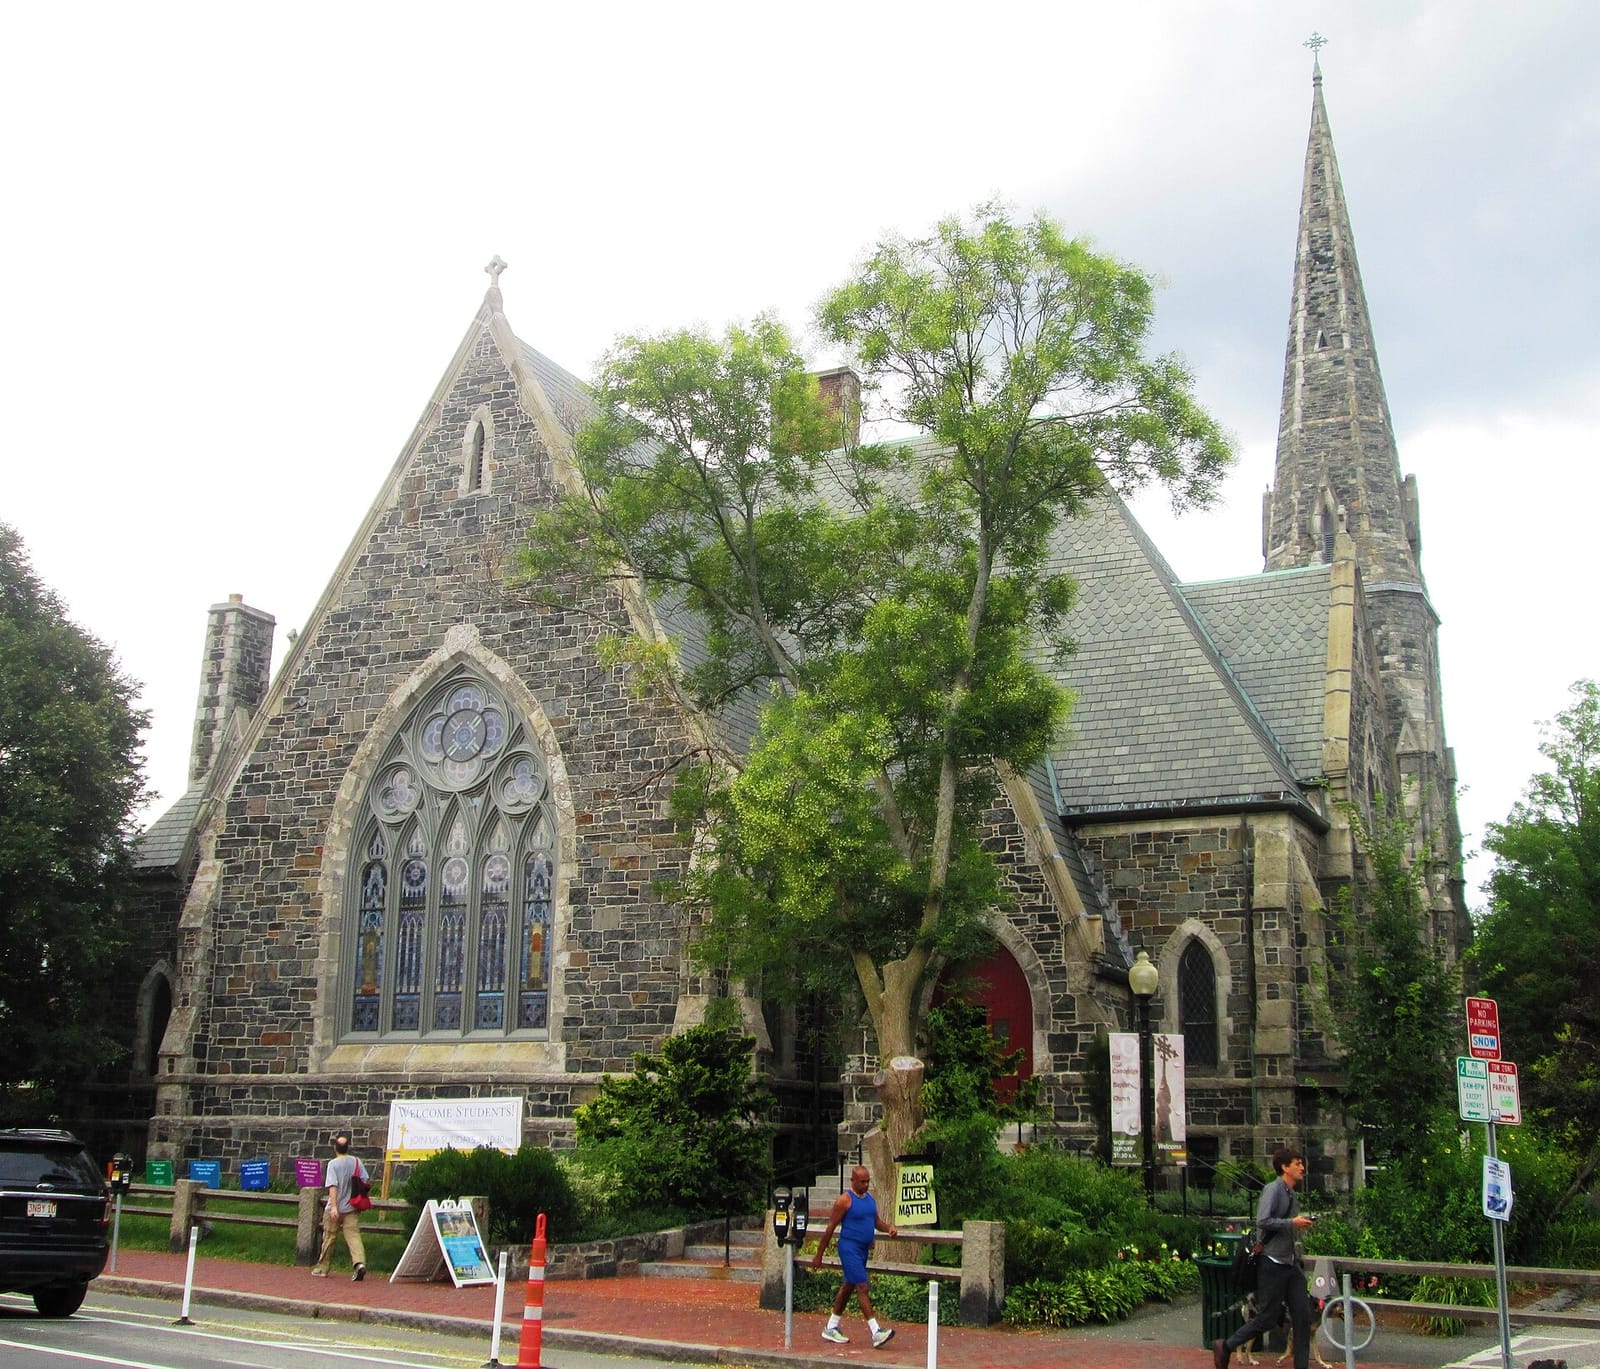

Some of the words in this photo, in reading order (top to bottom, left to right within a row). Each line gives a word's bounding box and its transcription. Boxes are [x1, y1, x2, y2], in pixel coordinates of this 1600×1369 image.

[1478, 1010, 1486, 1018] NO
[1470, 1017, 1497, 1029] PARKING
[1472, 1035, 1496, 1048] SNOW
[1460, 1061, 1466, 1075] 2
[1491, 1063, 1500, 1071] TOW
[1502, 1064, 1513, 1073] ZONE
[1498, 1075, 1507, 1083] NO
[1492, 1083, 1515, 1093] PARKING
[1465, 1092, 1482, 1100] EXCEPT
[398, 1106, 452, 1119] WELCOME
[456, 1105, 514, 1118] STUDENTS!
[902, 1172, 928, 1184] BLACK
[903, 1187, 926, 1200] LIVES
[899, 1203, 932, 1216] MATTER
